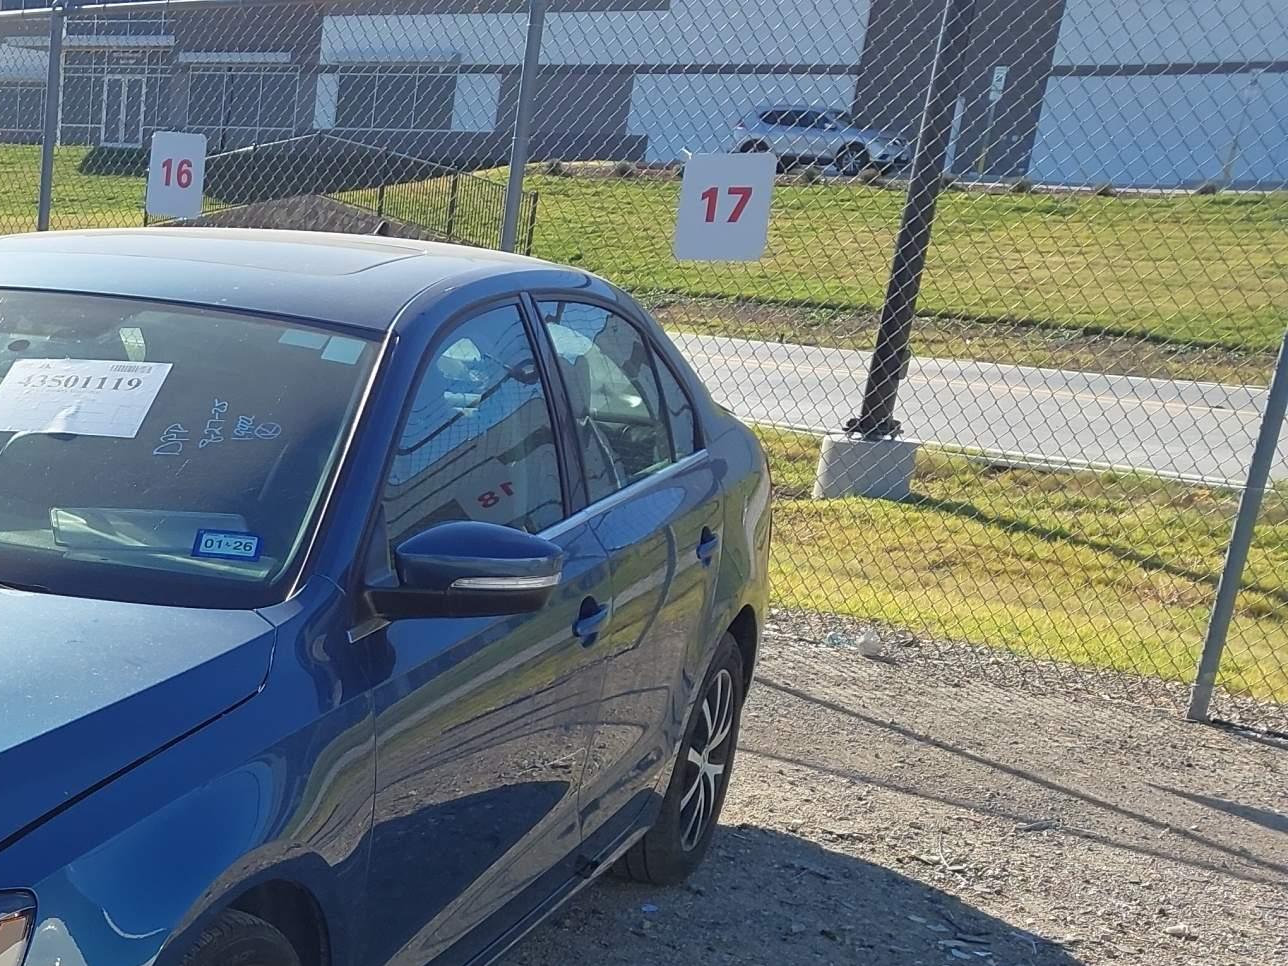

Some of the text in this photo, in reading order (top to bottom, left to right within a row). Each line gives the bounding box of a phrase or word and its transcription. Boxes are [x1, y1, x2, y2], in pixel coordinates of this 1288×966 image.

[161, 157, 194, 189] 16
[700, 186, 754, 223] 17
[17, 374, 144, 392] 43501119
